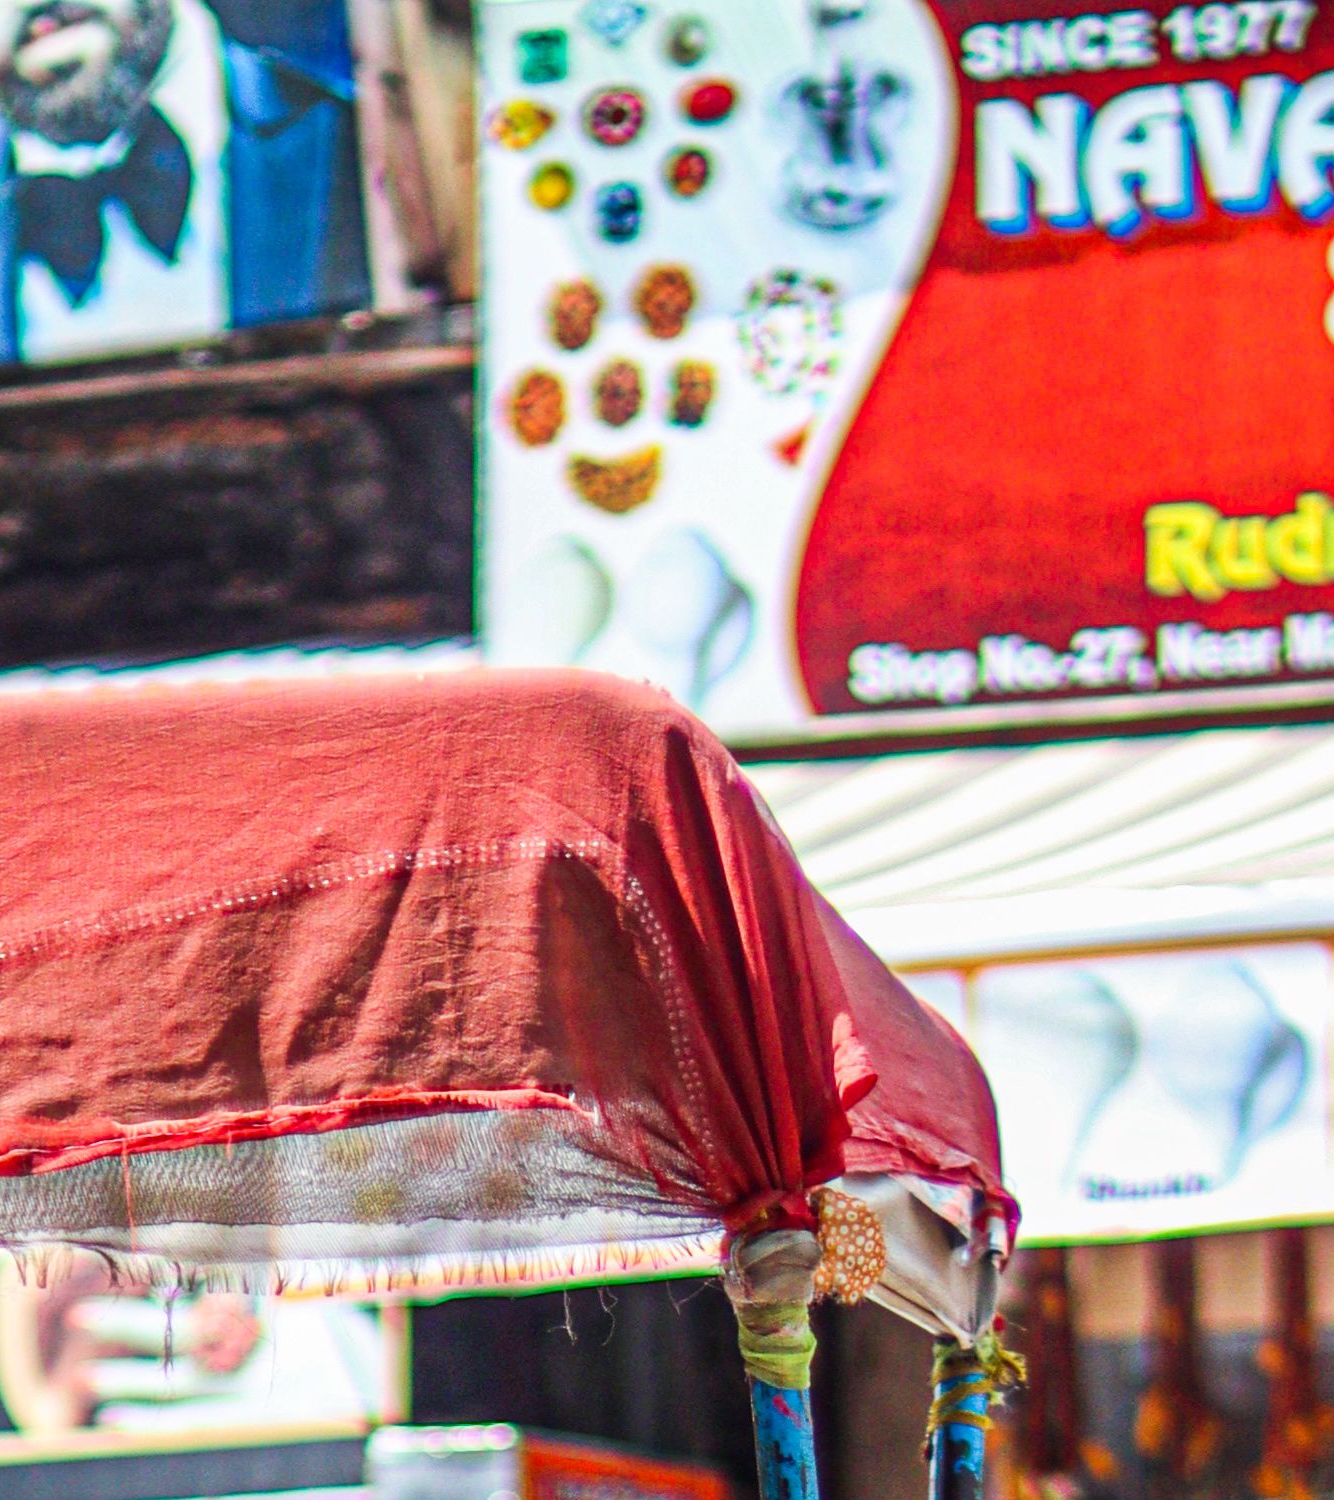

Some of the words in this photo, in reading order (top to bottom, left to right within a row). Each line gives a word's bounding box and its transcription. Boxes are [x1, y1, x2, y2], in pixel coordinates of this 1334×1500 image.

[960, 14, 1160, 81] SINCE
[1161, 0, 1318, 61] 1977
[1157, 622, 1280, 680] Near
